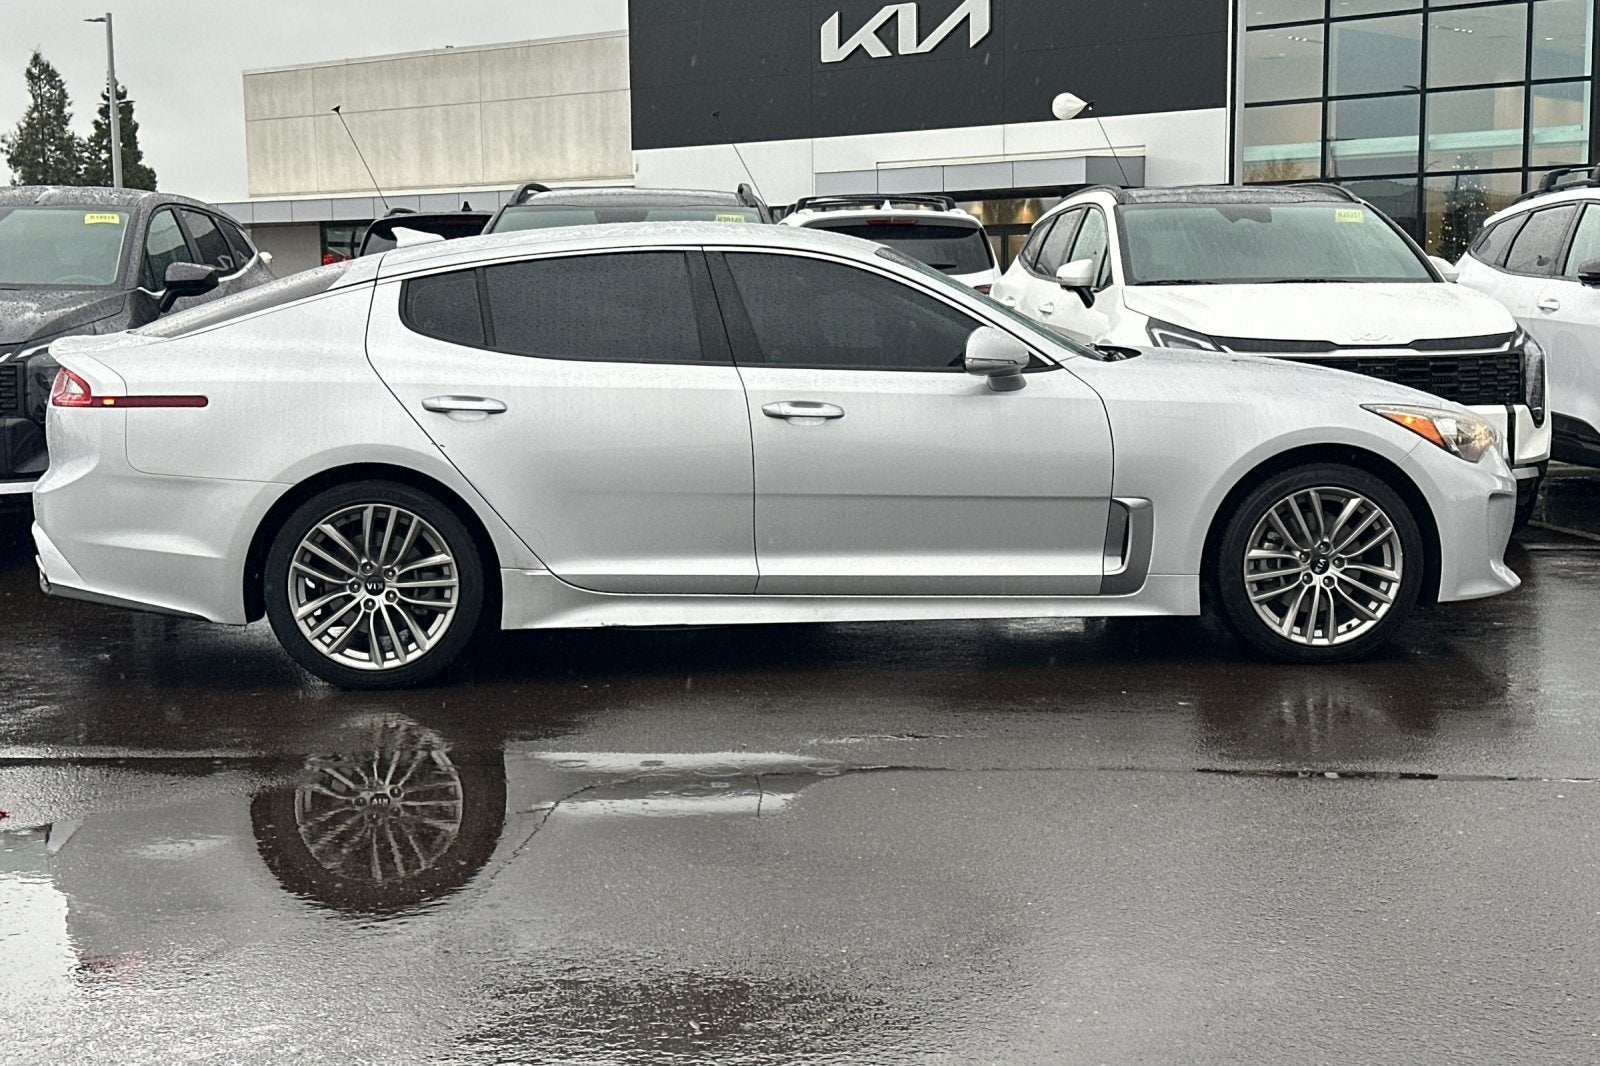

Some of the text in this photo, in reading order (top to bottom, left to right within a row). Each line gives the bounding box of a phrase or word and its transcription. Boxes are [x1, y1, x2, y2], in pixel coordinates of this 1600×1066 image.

[821, 0, 990, 62] KIA
[1313, 558, 1327, 573] KIA
[366, 582, 383, 590] KIA
